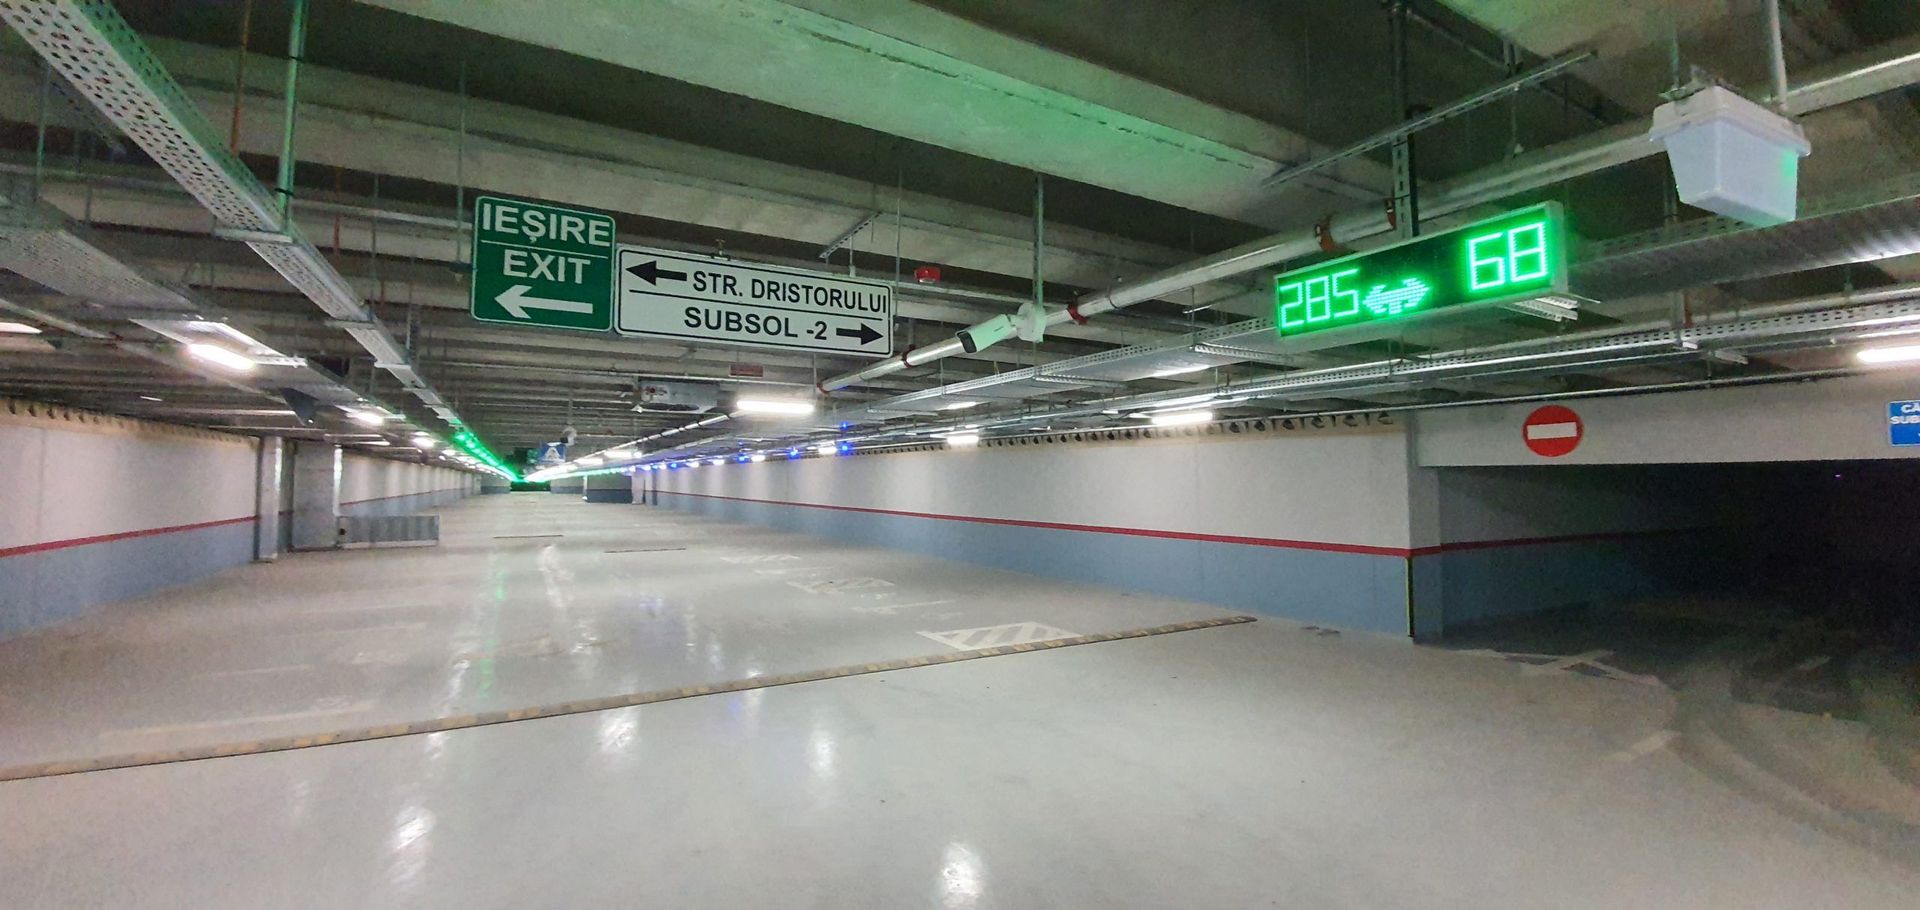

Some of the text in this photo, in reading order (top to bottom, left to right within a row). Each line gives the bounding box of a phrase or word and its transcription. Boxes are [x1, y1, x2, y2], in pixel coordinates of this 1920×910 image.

[503, 248, 591, 285] EXIT
[1279, 221, 1549, 328] 285 68
[693, 270, 887, 313] STR. DRISTORULUI
[684, 306, 827, 341] SUBSOL -2
